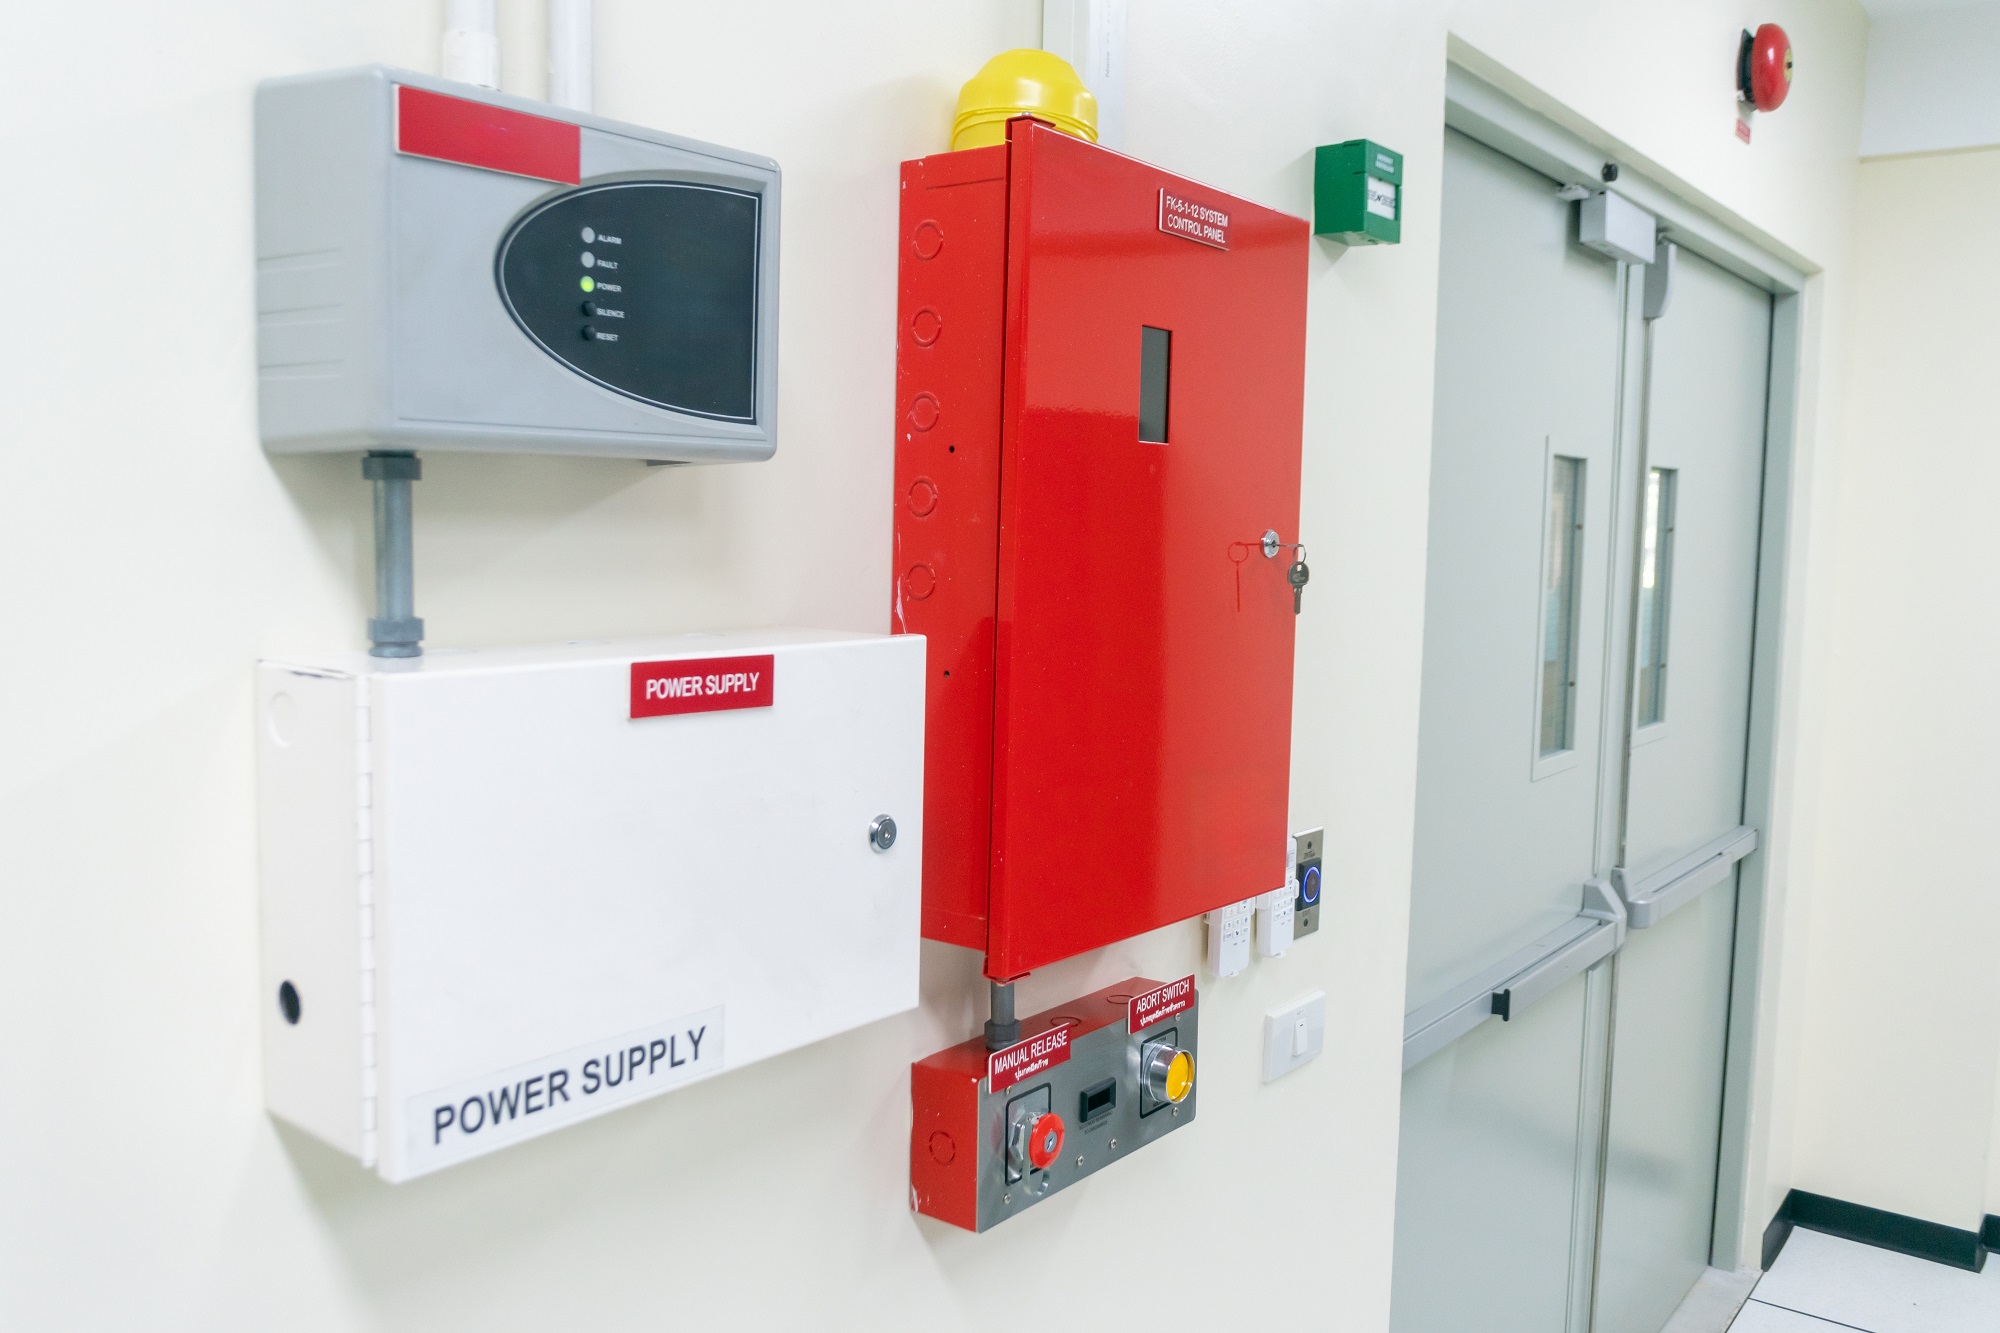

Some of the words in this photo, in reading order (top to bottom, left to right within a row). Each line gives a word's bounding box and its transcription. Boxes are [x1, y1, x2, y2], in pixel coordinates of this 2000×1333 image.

[1199, 207, 1229, 227] SYSTEM
[1167, 214, 1203, 237] CONTROL
[1203, 225, 1226, 243] PANEL
[597, 234, 622, 245] ALARM
[596, 259, 618, 269] FAULT
[596, 282, 622, 292] POWER
[596, 307, 625, 319] SILENCE
[596, 332, 618, 341] RESET
[645, 673, 703, 700] POWER
[705, 671, 760, 695] SUPPLY
[1136, 992, 1162, 1016] ABORT
[1162, 979, 1191, 1004] SWITCH
[994, 1046, 1030, 1075] MANUAL
[1030, 1030, 1067, 1058] RELEASE
[432, 1067, 571, 1145] POWER
[580, 1025, 708, 1096] SUPPLY
